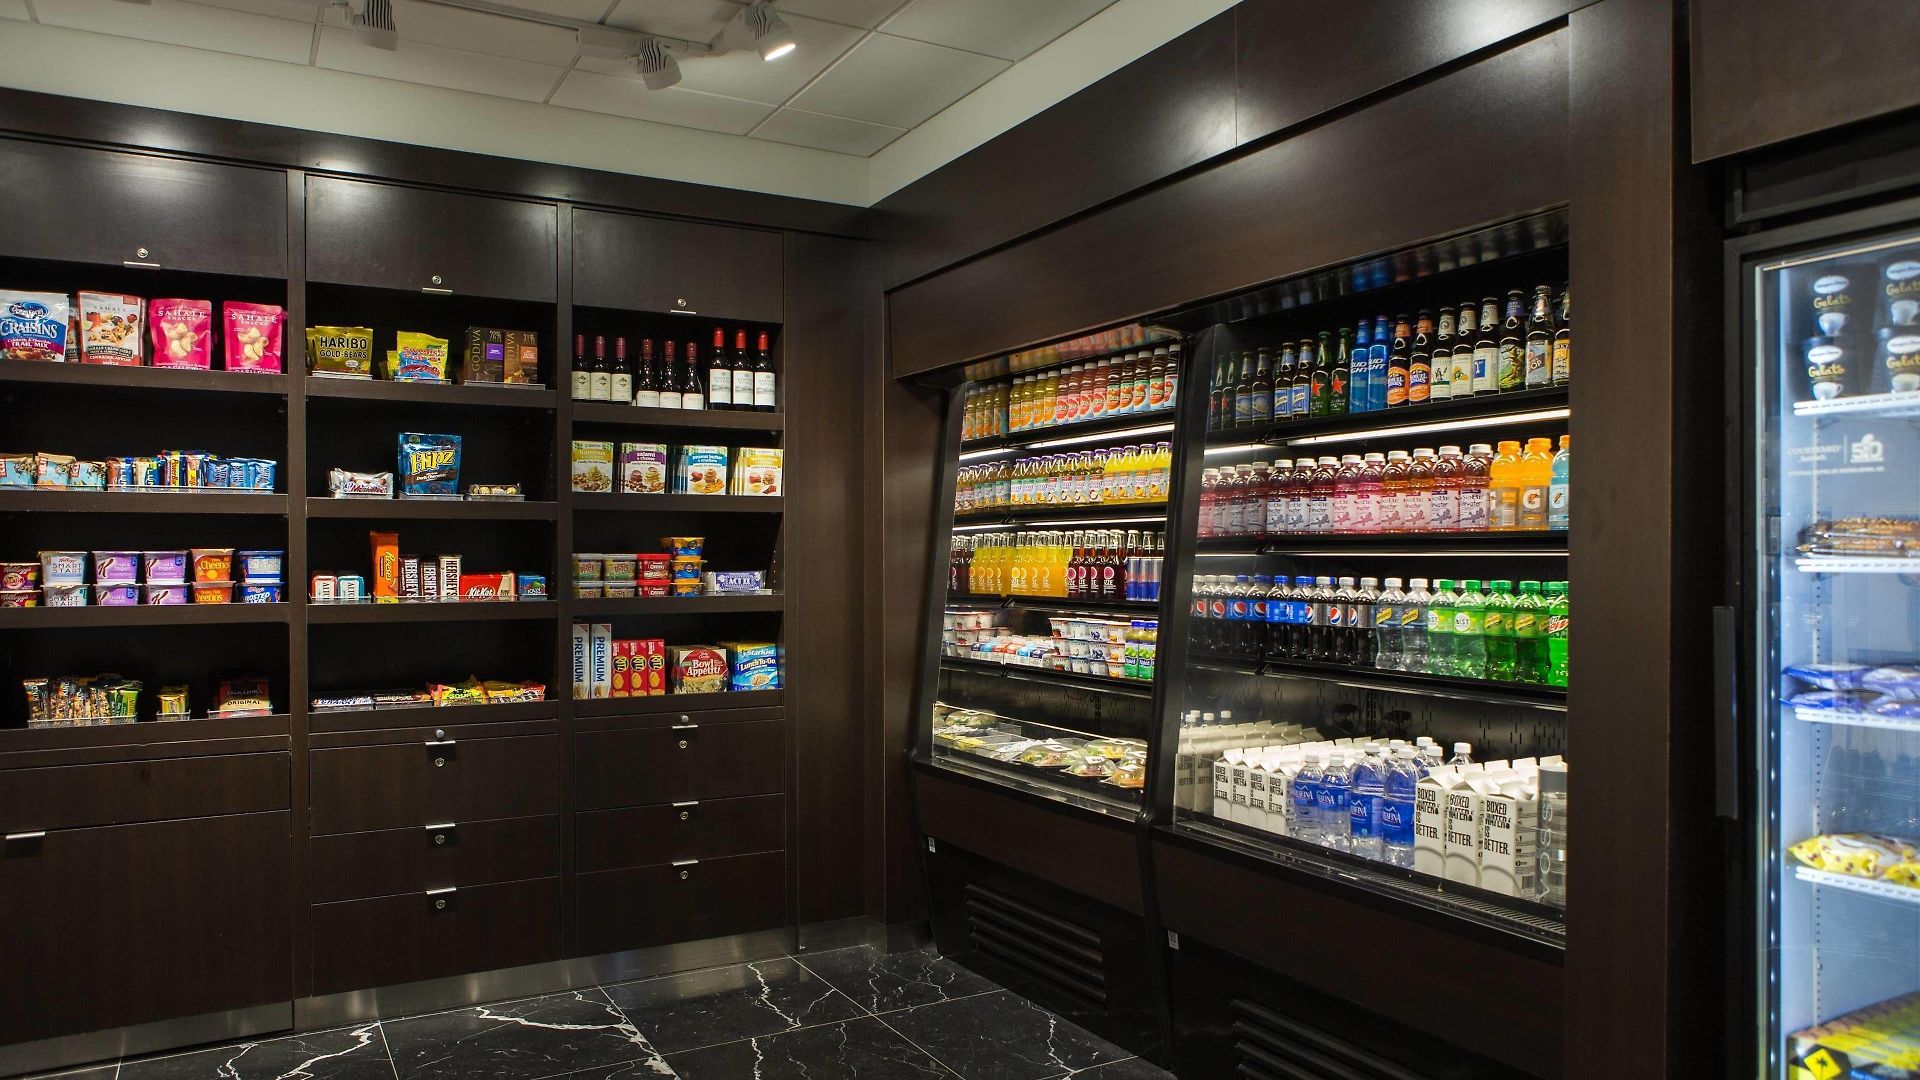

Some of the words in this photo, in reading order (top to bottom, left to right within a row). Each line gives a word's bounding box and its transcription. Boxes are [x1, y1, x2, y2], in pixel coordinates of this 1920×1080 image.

[158, 310, 206, 318] SAHALE
[231, 313, 277, 322] SAHALE
[1, 321, 58, 338] CRAISINS
[320, 335, 367, 349] HARIBO
[472, 328, 480, 372] GODIVA
[320, 349, 367, 358] GOLD-BEARS
[1808, 364, 1846, 377] Gelato
[409, 449, 456, 475] Flipz
[1522, 488, 1541, 509] G
[201, 561, 231, 569] Cheerios
[384, 551, 395, 581] Reese's
[405, 559, 418, 598] HERSHEY'S
[424, 562, 437, 599] HERSHEY'S
[446, 560, 457, 598] HERSHEY'S
[574, 637, 583, 683] PREMIUM
[596, 637, 605, 682] PREMIUM
[692, 659, 713, 668] Bowl
[740, 660, 758, 671] Lunch
[758, 659, 776, 667] To-Go
[1417, 787, 1436, 802] BOXED
[1450, 793, 1470, 809] BOXED
[1416, 800, 1435, 815] WATER
[1448, 806, 1468, 822] WATER
[1486, 800, 1507, 815] BOXED
[1416, 811, 1421, 824] IS
[1448, 818, 1453, 831] IS
[1485, 813, 1507, 829] WATER
[1415, 823, 1440, 840] BETTER.
[1448, 830, 1473, 847] BETTER.
[1484, 825, 1490, 838] IS
[1484, 838, 1511, 856] BETTER.
